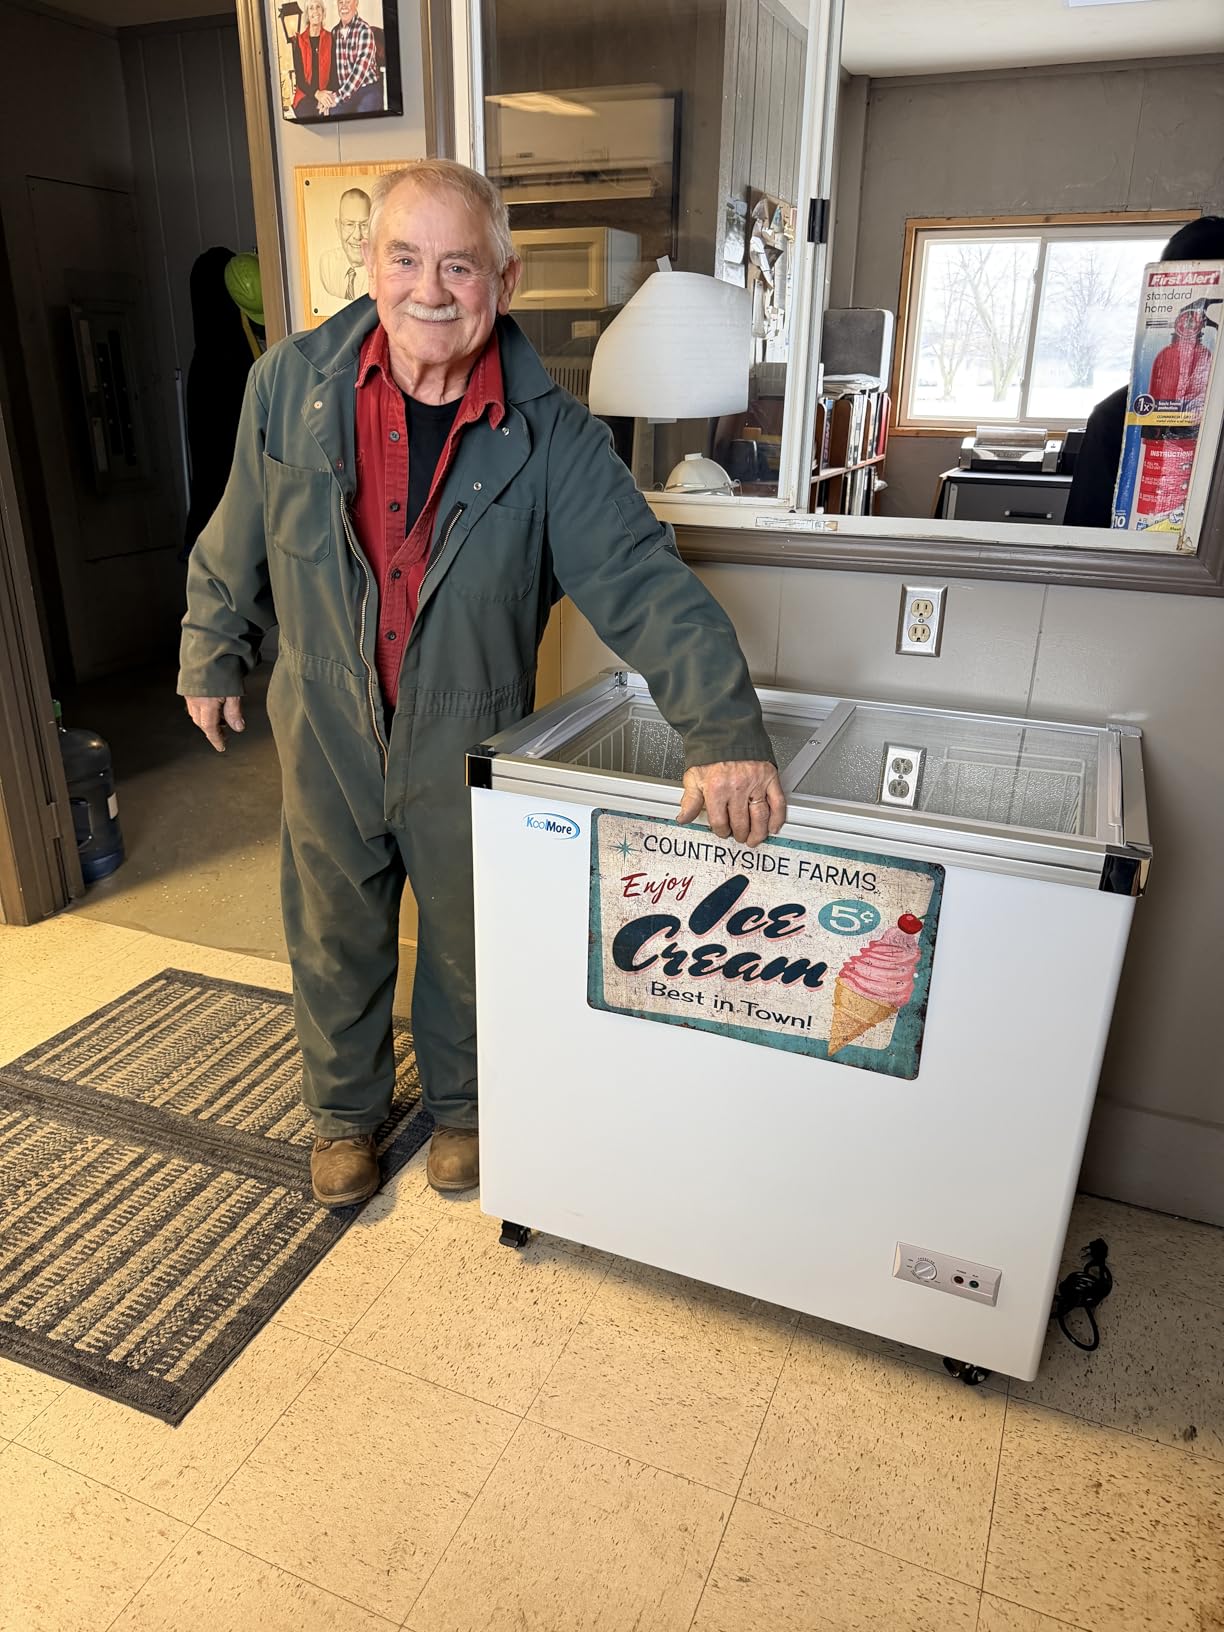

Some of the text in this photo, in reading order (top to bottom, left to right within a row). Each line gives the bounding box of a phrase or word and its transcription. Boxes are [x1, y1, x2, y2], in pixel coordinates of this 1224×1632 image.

[1151, 272, 1217, 286] First Alert
[1144, 302, 1173, 313] home
[1146, 288, 1193, 301] standard
[526, 816, 573, 835] KoolMore
[643, 834, 877, 892] COUNTRYSIDE FARMS
[620, 872, 694, 905] Enjoy
[688, 873, 807, 941] Ice
[829, 904, 875, 932] 5¢
[612, 913, 829, 992] Cream
[651, 980, 813, 1031] Best in Town!
